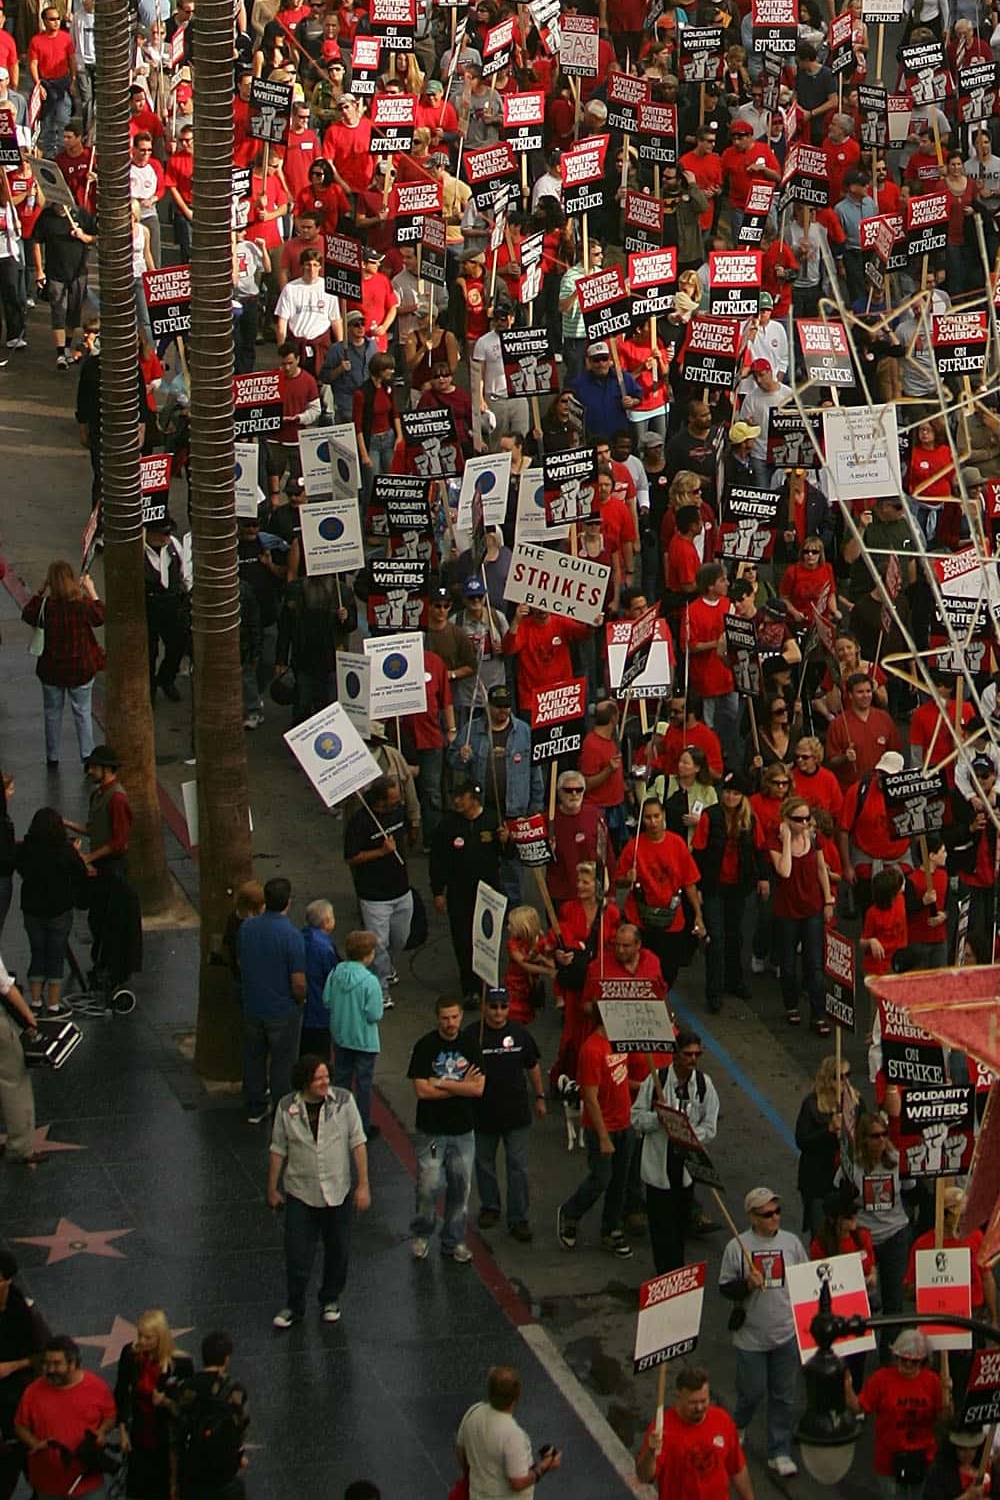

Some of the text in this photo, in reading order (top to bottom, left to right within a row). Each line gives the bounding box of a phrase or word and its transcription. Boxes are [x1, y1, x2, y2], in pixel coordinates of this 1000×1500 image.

[563, 35, 593, 50] SAG
[376, 99, 414, 107] WRITERS
[375, 113, 413, 123] AMERICA
[387, 129, 397, 138] ON
[371, 138, 411, 151] STRIKE
[912, 195, 947, 210] WRITERS
[911, 210, 947, 226] AMERICA
[923, 228, 933, 238] ON
[908, 234, 946, 255] STRIKE
[713, 256, 756, 265] WRITERS
[715, 265, 743, 274] GUILD
[713, 273, 757, 282] AMERICA
[729, 289, 741, 300] ON
[712, 300, 757, 315] STRIKE
[691, 322, 735, 335] WRITERS
[689, 340, 734, 353] AMERICA
[703, 358, 715, 368] ON
[236, 375, 279, 389] WRITERS
[685, 366, 732, 385] STRIKE
[235, 392, 280, 404] AMERICA
[250, 408, 263, 419] ON
[235, 416, 280, 435] STRIKE
[373, 562, 424, 571] SOLIDARITY
[517, 544, 608, 579] THE GUILD
[373, 573, 424, 584] WRITERS
[513, 563, 601, 606] STRIKES
[525, 592, 577, 616] BACK
[537, 684, 581, 703] WRITERS
[536, 704, 581, 724] AMERICA
[550, 726, 563, 739] ON
[533, 734, 581, 761] STRIKE
[616, 1041, 674, 1053] STRIKE
[905, 1047, 919, 1060] ON
[888, 1060, 943, 1084] STRIKE
[906, 1088, 970, 1102] SOLIDARITY
[906, 1103, 968, 1119] WRITERS
[638, 1339, 693, 1371] STRIKE
